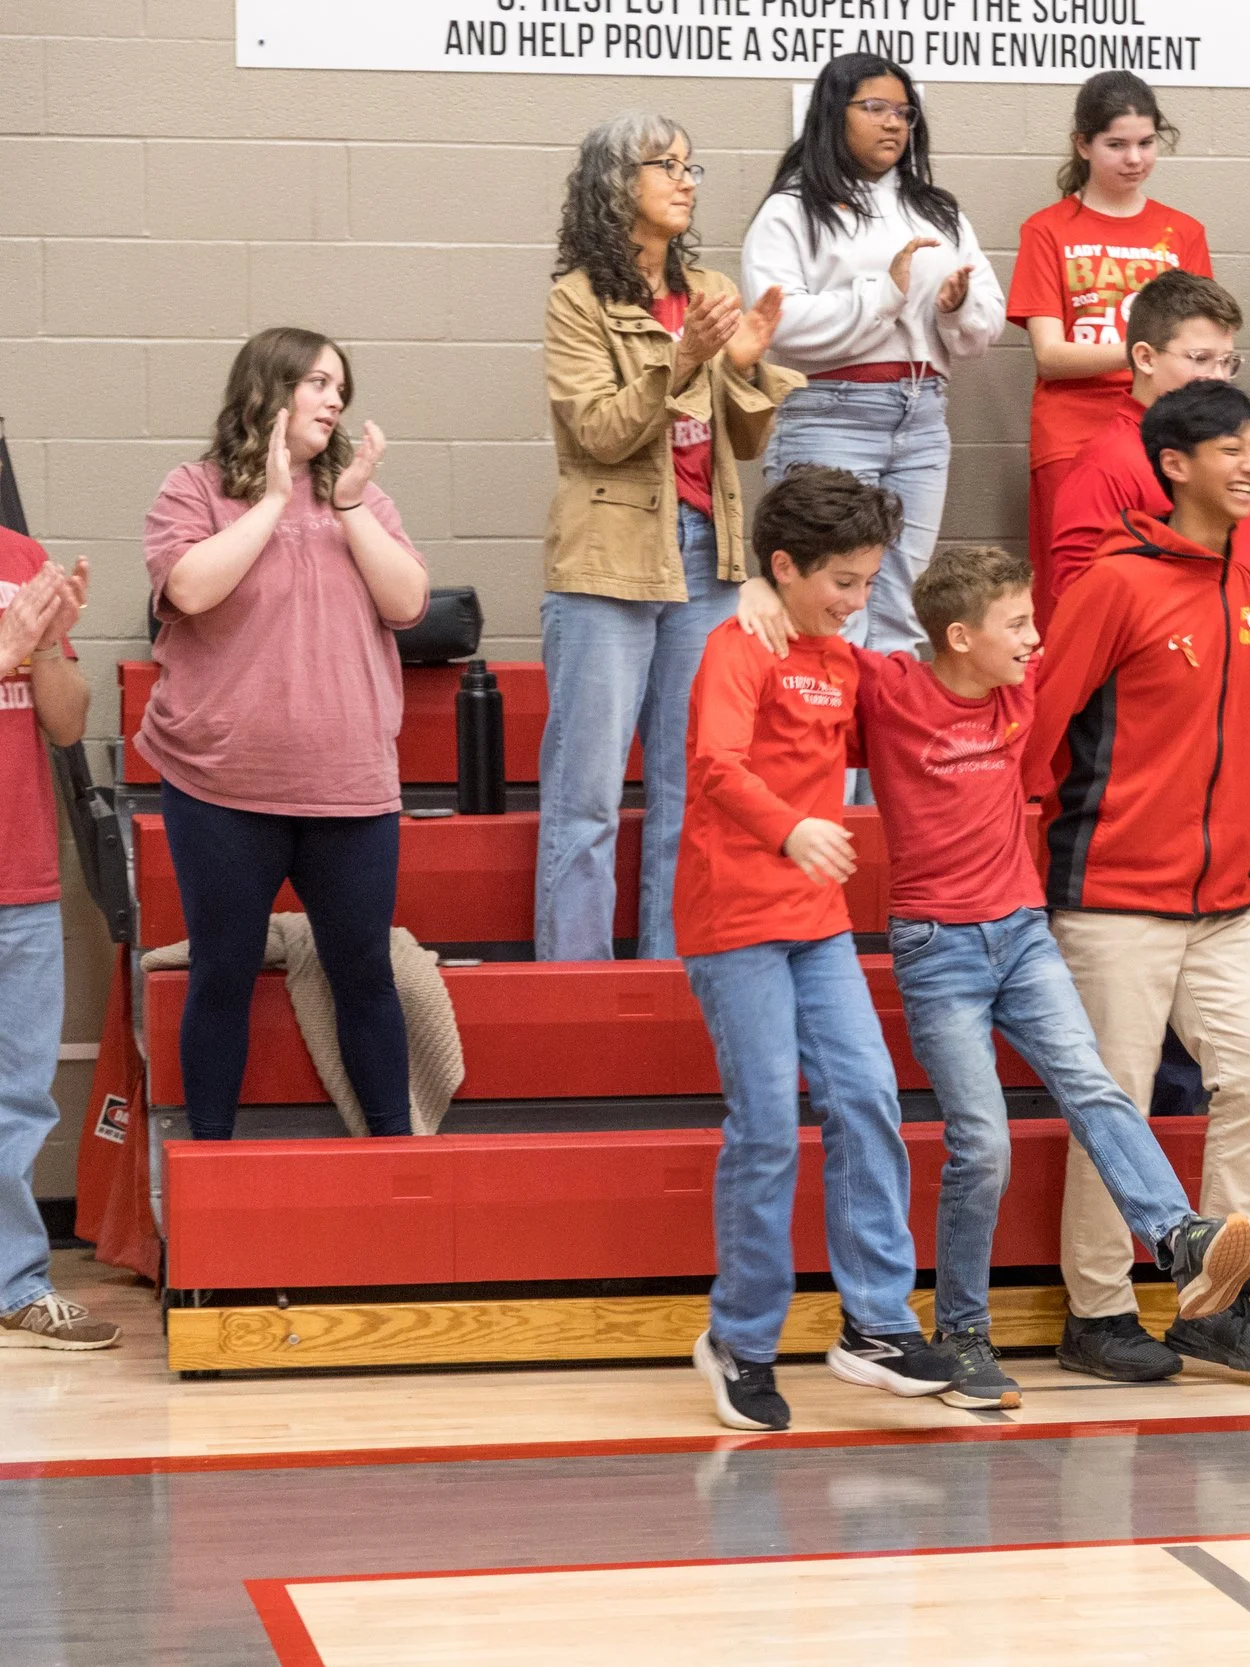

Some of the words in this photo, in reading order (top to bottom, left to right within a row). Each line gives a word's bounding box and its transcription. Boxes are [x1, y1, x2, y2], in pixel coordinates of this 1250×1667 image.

[444, 20, 507, 56] AND
[519, 21, 594, 58] HELP
[605, 23, 733, 61] PROVIDE
[743, 26, 762, 61] A
[772, 27, 844, 62] SAFE
[857, 29, 914, 64] AND
[925, 31, 980, 66] FUN
[992, 33, 1201, 70] ENVIRONMENT
[1064, 244, 1103, 259] LADY
[1066, 257, 1166, 292] BAC
